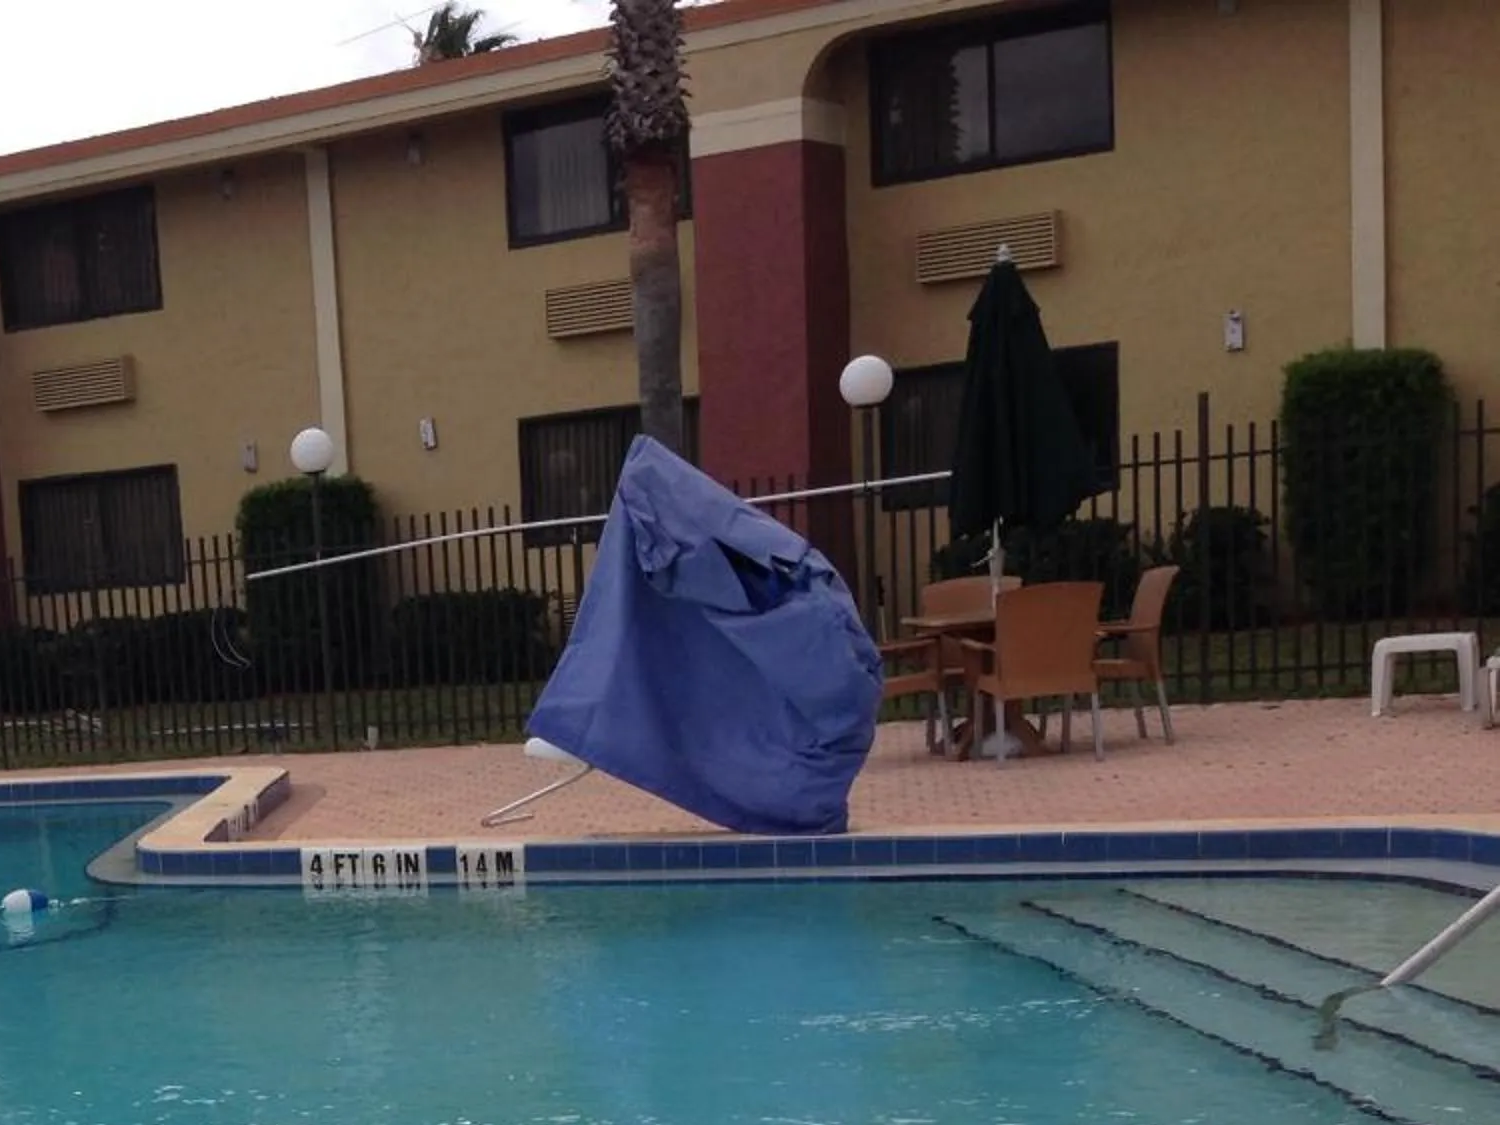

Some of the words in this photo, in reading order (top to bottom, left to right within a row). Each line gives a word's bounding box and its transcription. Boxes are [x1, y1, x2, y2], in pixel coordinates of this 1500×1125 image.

[310, 853, 323, 874] 4
[333, 853, 359, 875] FT
[396, 852, 419, 873] IN
